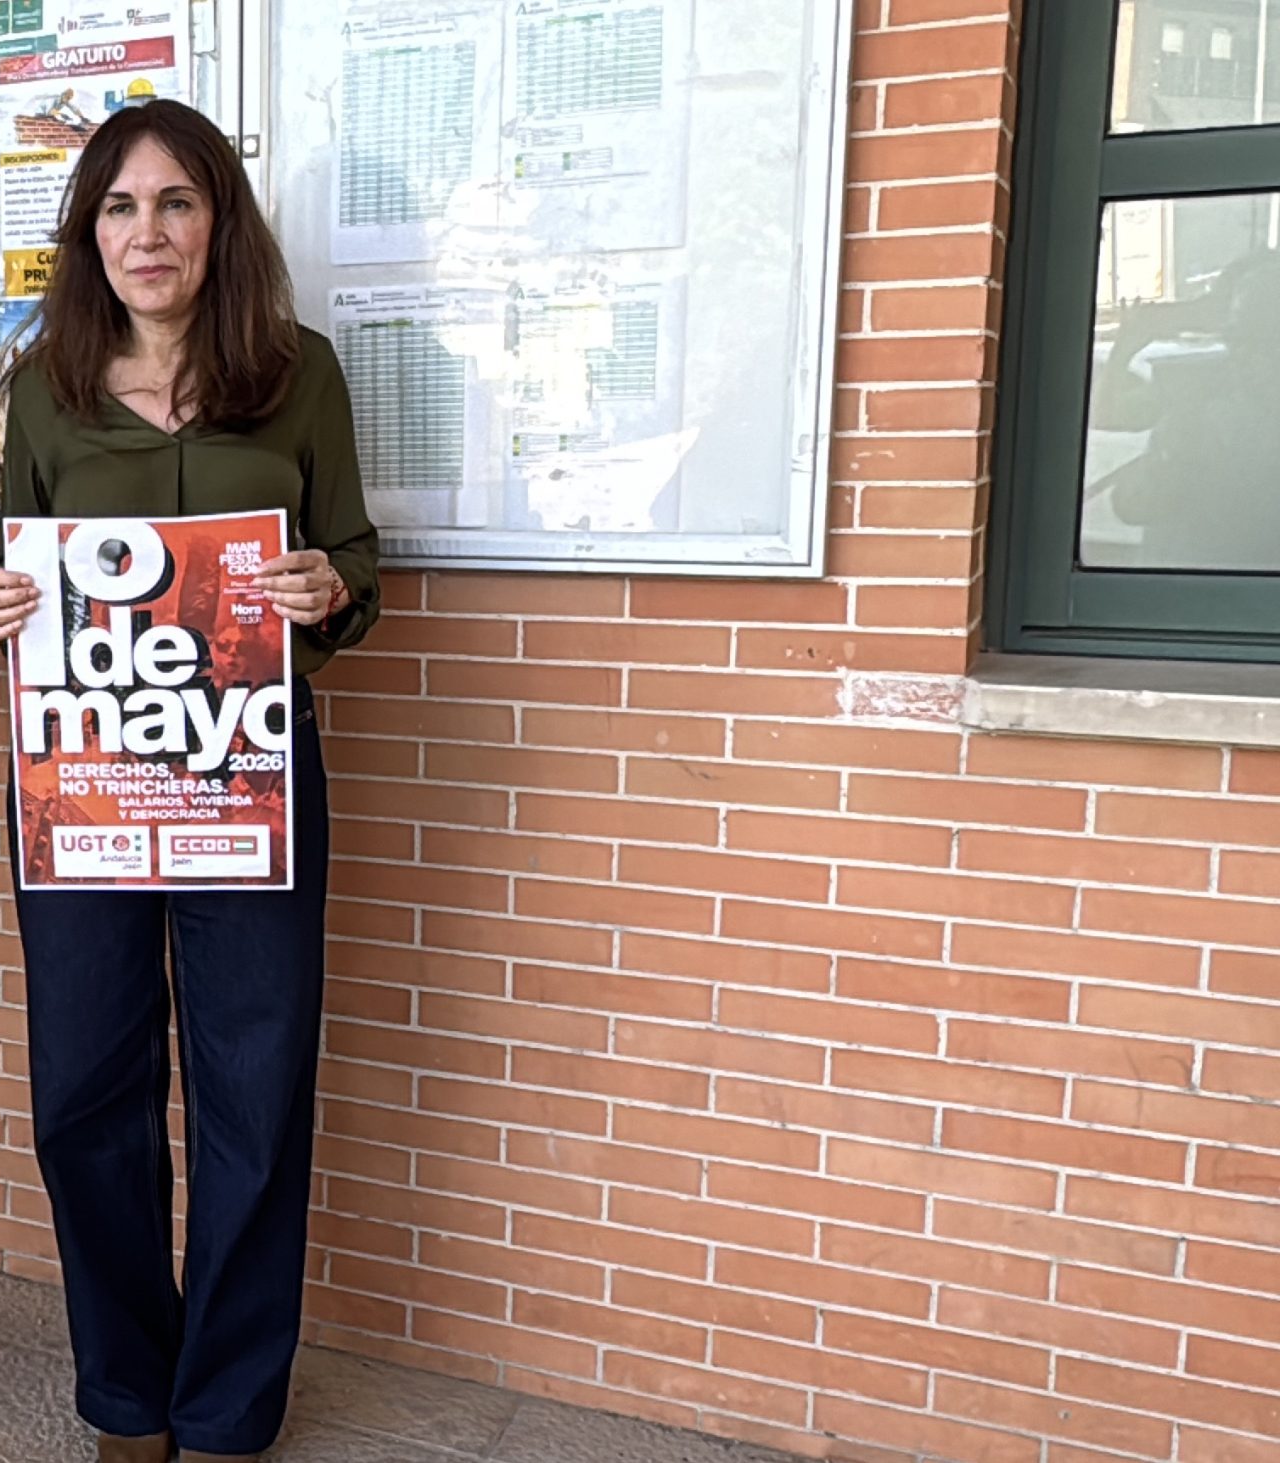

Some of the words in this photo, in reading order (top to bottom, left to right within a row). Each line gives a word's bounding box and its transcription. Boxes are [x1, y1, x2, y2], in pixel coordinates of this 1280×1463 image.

[42, 45, 126, 69] GRATUITO
[225, 540, 261, 554] MANI
[219, 553, 263, 567] FESTA
[231, 602, 263, 617] Hora
[70, 606, 199, 690] de
[20, 685, 286, 772] mayo
[58, 762, 174, 781] DERECHOS,
[228, 753, 285, 772] 2026
[59, 780, 90, 796] NO
[93, 778, 229, 796] TRINCHERAS.
[191, 795, 253, 807] VIVIENDA
[119, 809, 126, 820] Y
[130, 807, 220, 820] DEMOCRACIA
[60, 834, 108, 852] UGT
[174, 838, 231, 853] CCOO
